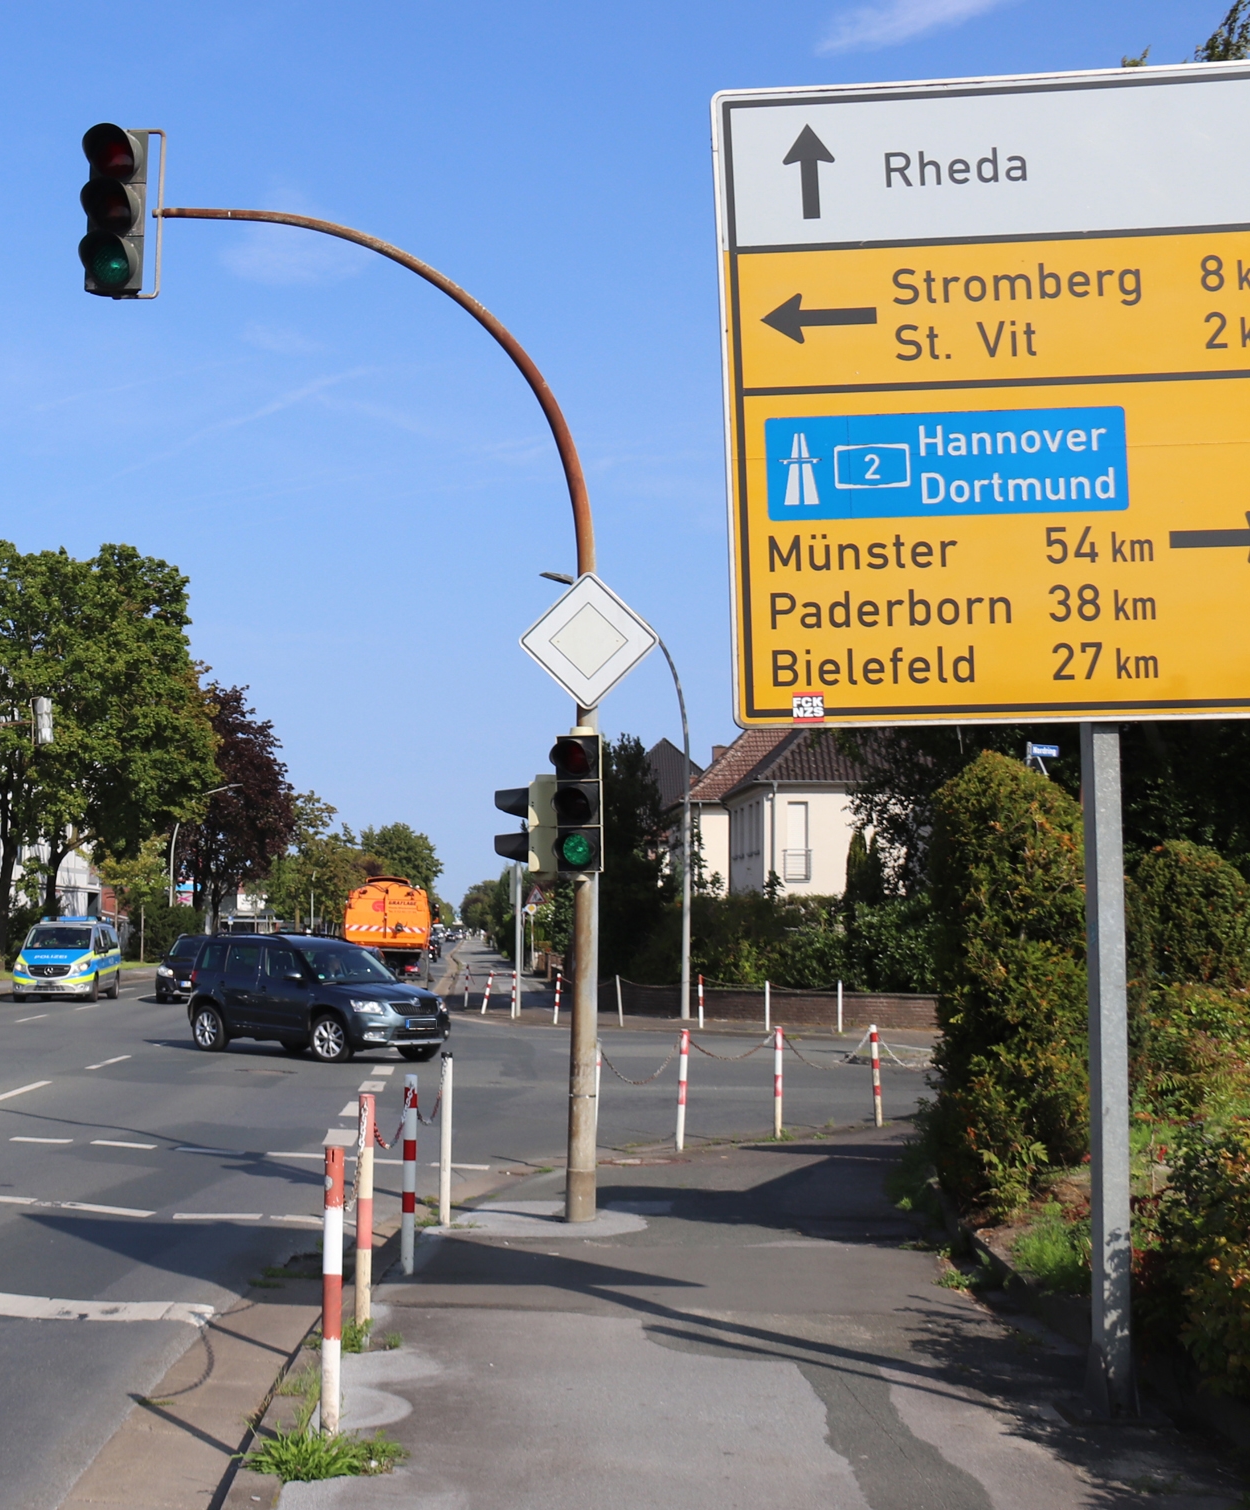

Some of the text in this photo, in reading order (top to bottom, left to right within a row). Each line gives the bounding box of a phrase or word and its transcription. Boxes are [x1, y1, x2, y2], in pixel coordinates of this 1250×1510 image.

[884, 146, 1028, 188] Rheda
[892, 254, 1250, 307] Stromberg 8 k
[895, 311, 1250, 362] St. Vit 2 k
[918, 425, 1107, 457] Hannover
[864, 453, 881, 480] 2
[920, 466, 1116, 505] Dortmund
[768, 525, 1154, 573] Münster 54 km
[770, 583, 1157, 630] Paderborn 38 km
[771, 641, 1159, 688] Bielefeld 27 km
[793, 697, 823, 707] FCK
[793, 707, 824, 717] NZS
